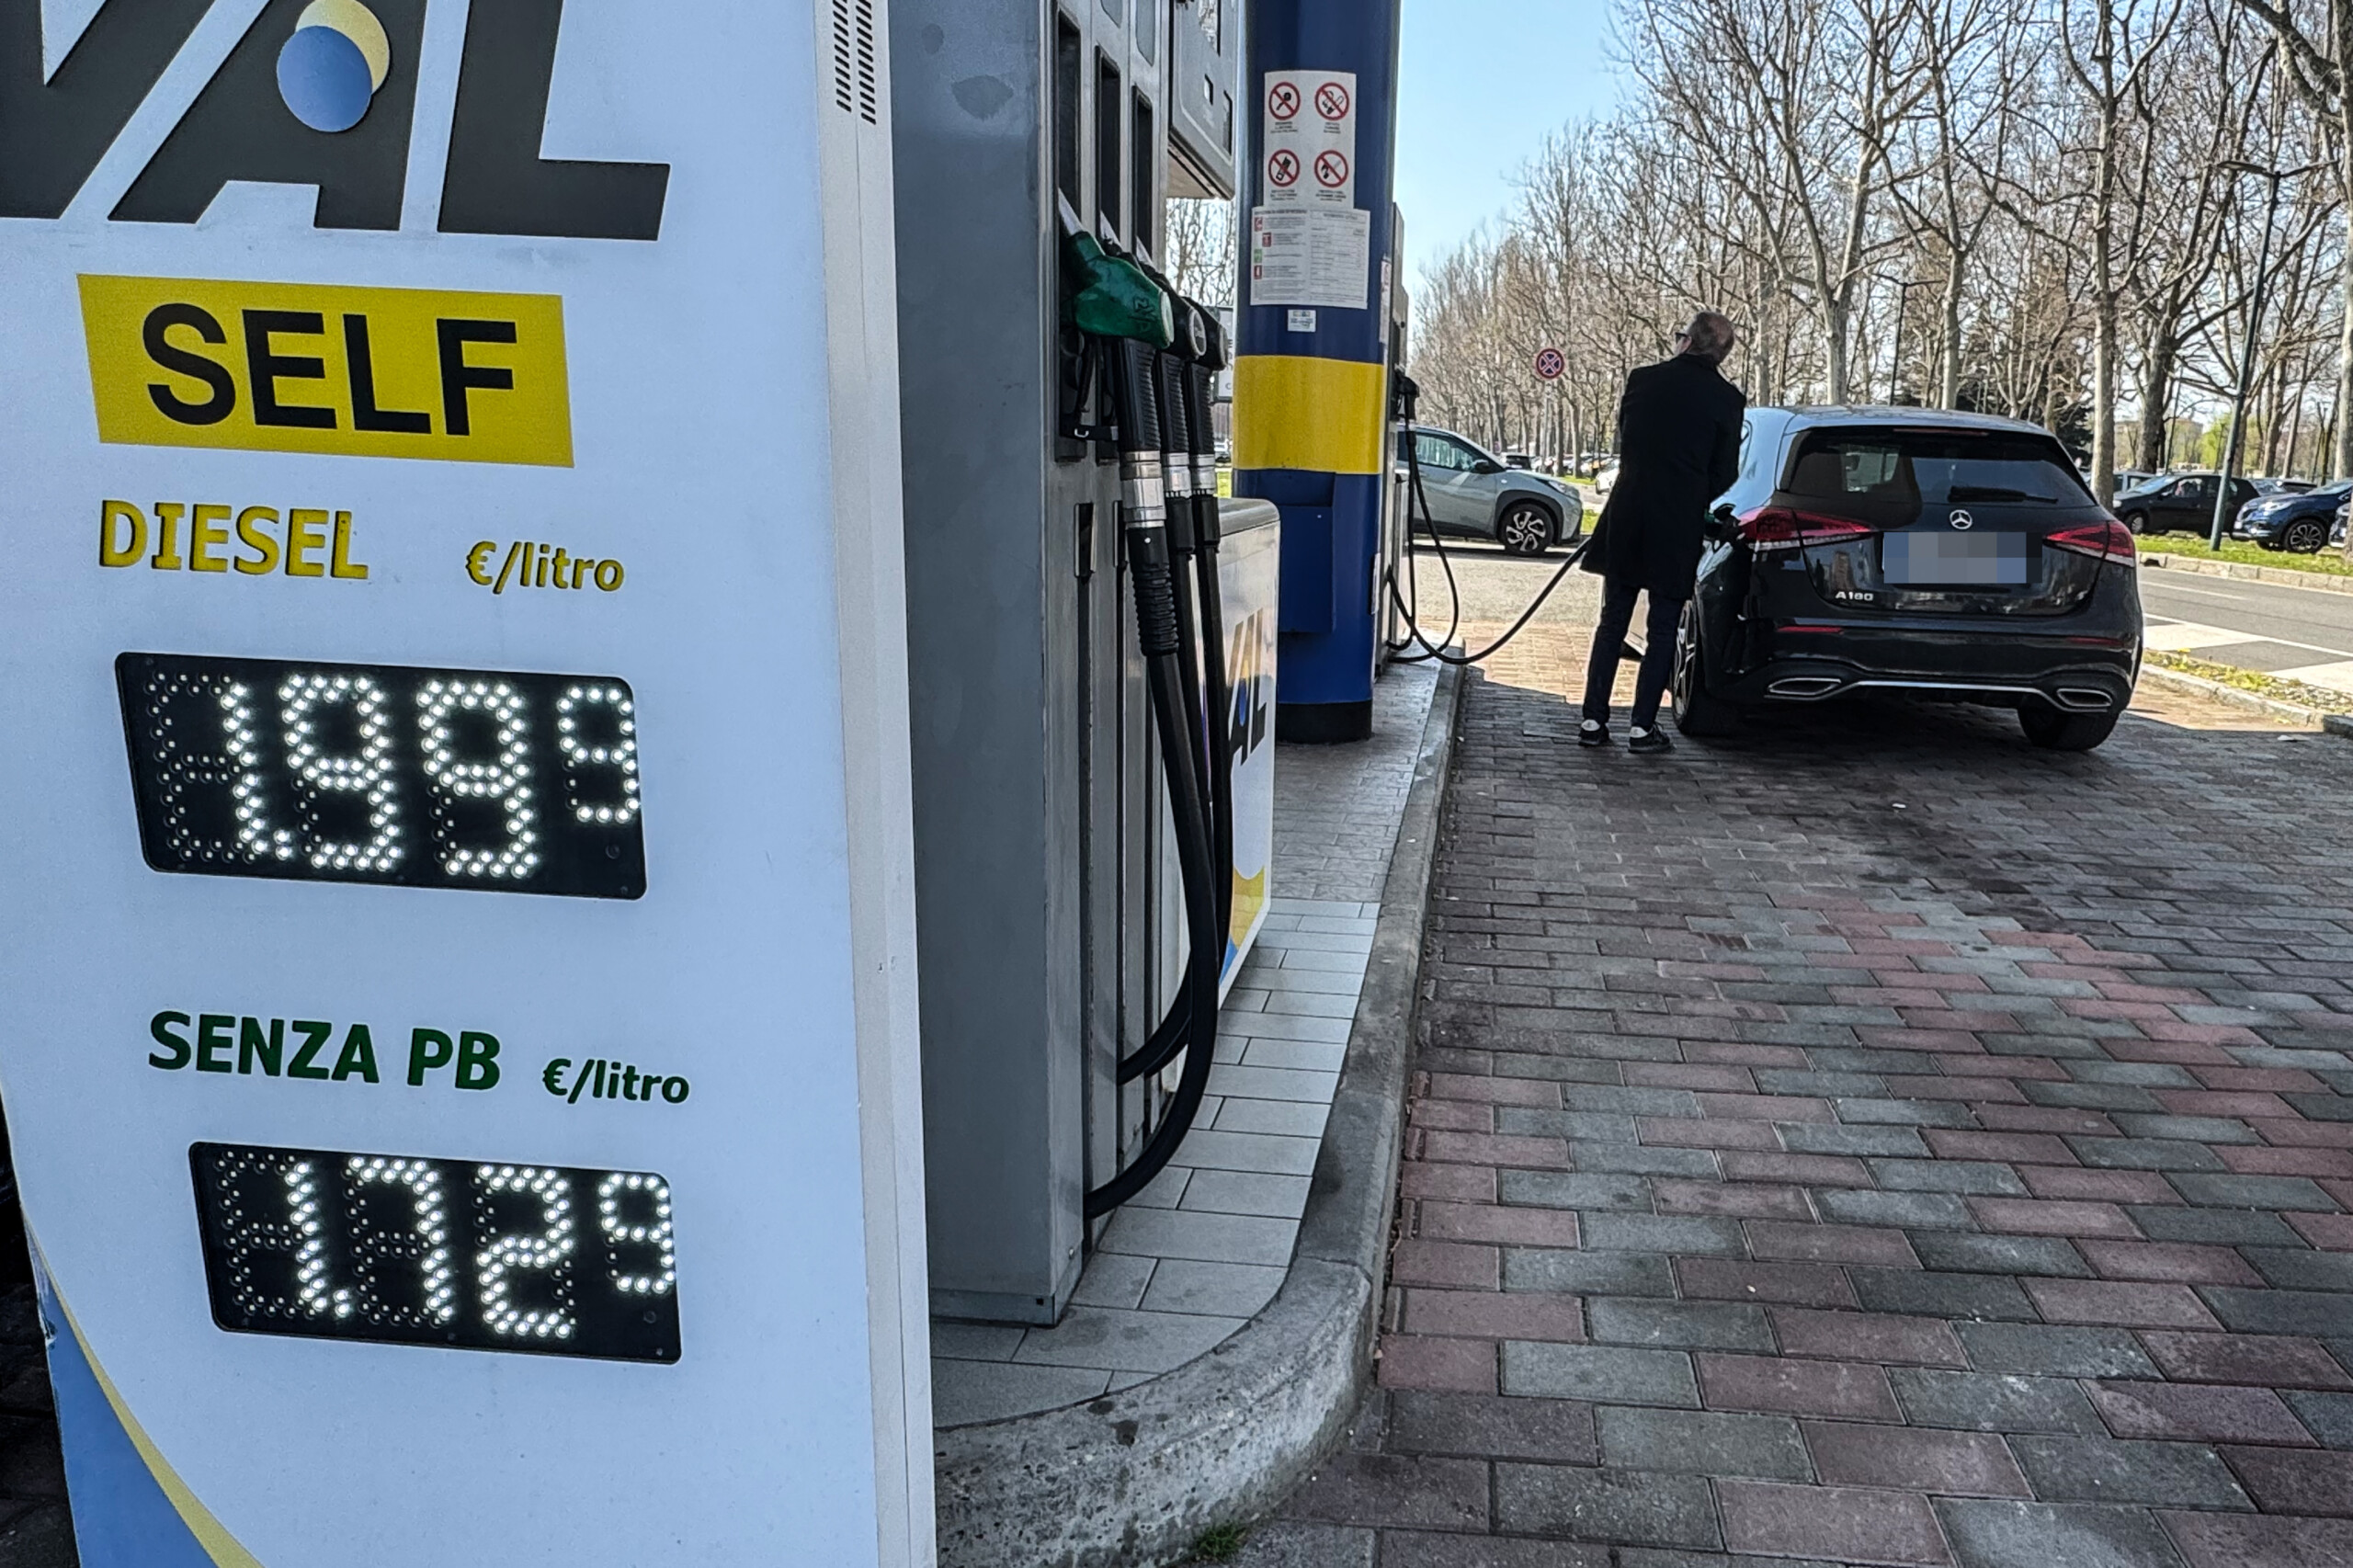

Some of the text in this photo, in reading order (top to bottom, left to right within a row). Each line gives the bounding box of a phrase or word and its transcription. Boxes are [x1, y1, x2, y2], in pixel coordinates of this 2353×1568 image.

[142, 303, 517, 437] SELF
[99, 499, 625, 596] DIESEL €/litro
[148, 1011, 689, 1105] SENZA PB €/litro
